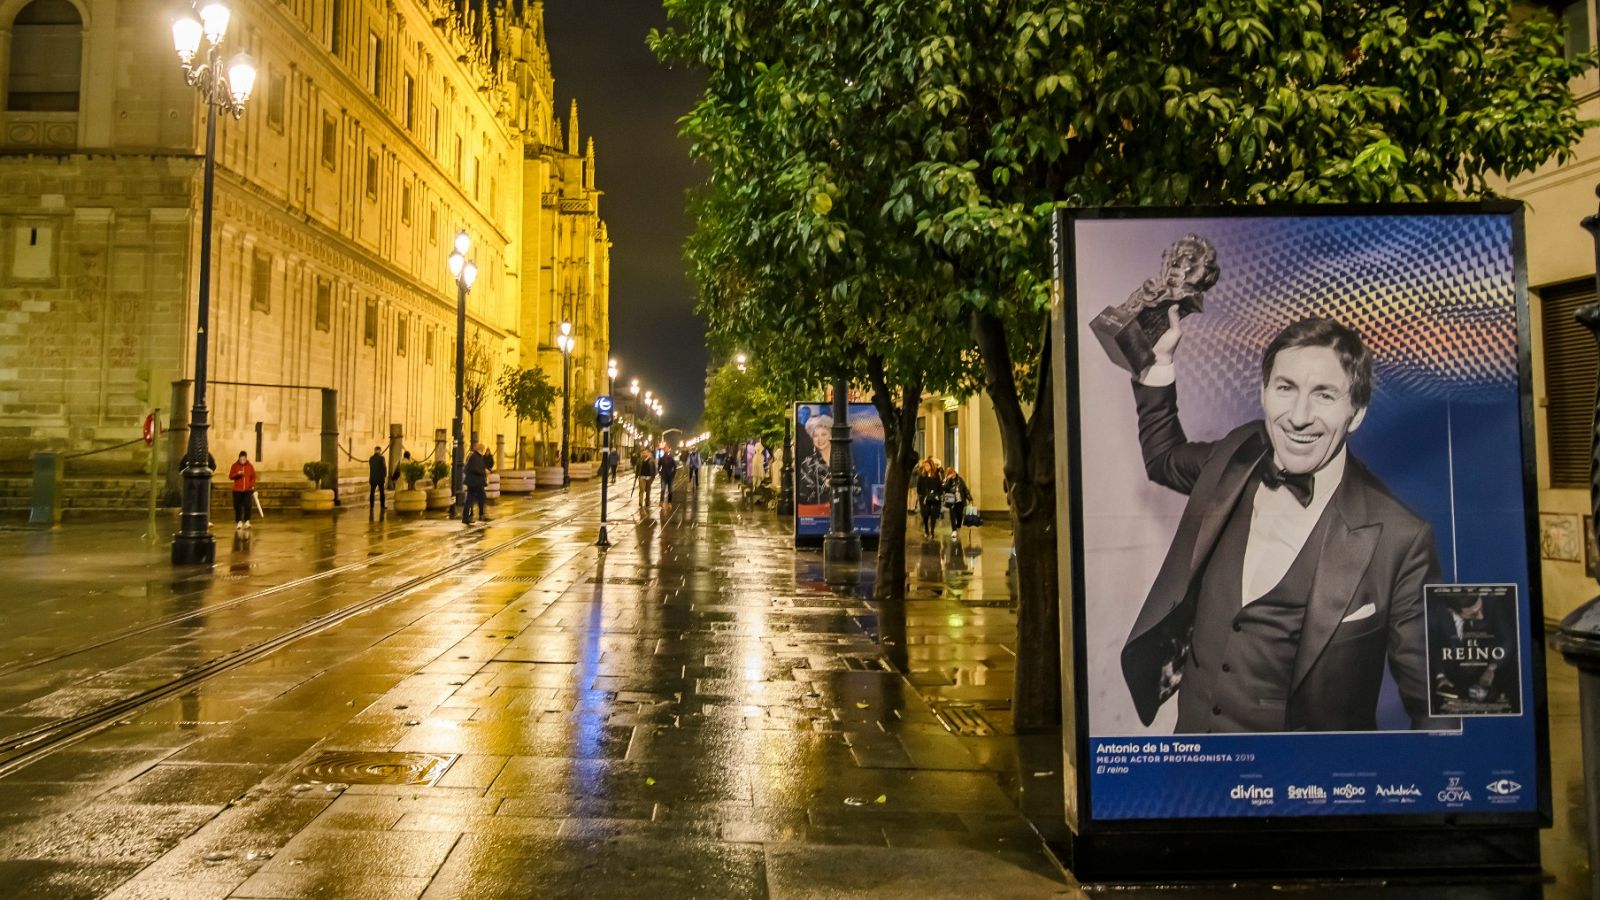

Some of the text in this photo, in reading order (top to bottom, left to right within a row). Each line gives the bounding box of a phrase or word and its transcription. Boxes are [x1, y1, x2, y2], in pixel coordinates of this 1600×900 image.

[1467, 639, 1478, 647] EL
[1442, 646, 1505, 660] REINO
[1096, 742, 1201, 754] Antonio de la Torre
[1096, 753, 1255, 763] MEJOR ACTOR PROTAGONISTA 2019
[1096, 765, 1129, 774] El reino
[1230, 784, 1274, 799] divina
[1437, 790, 1472, 802] GOYA
